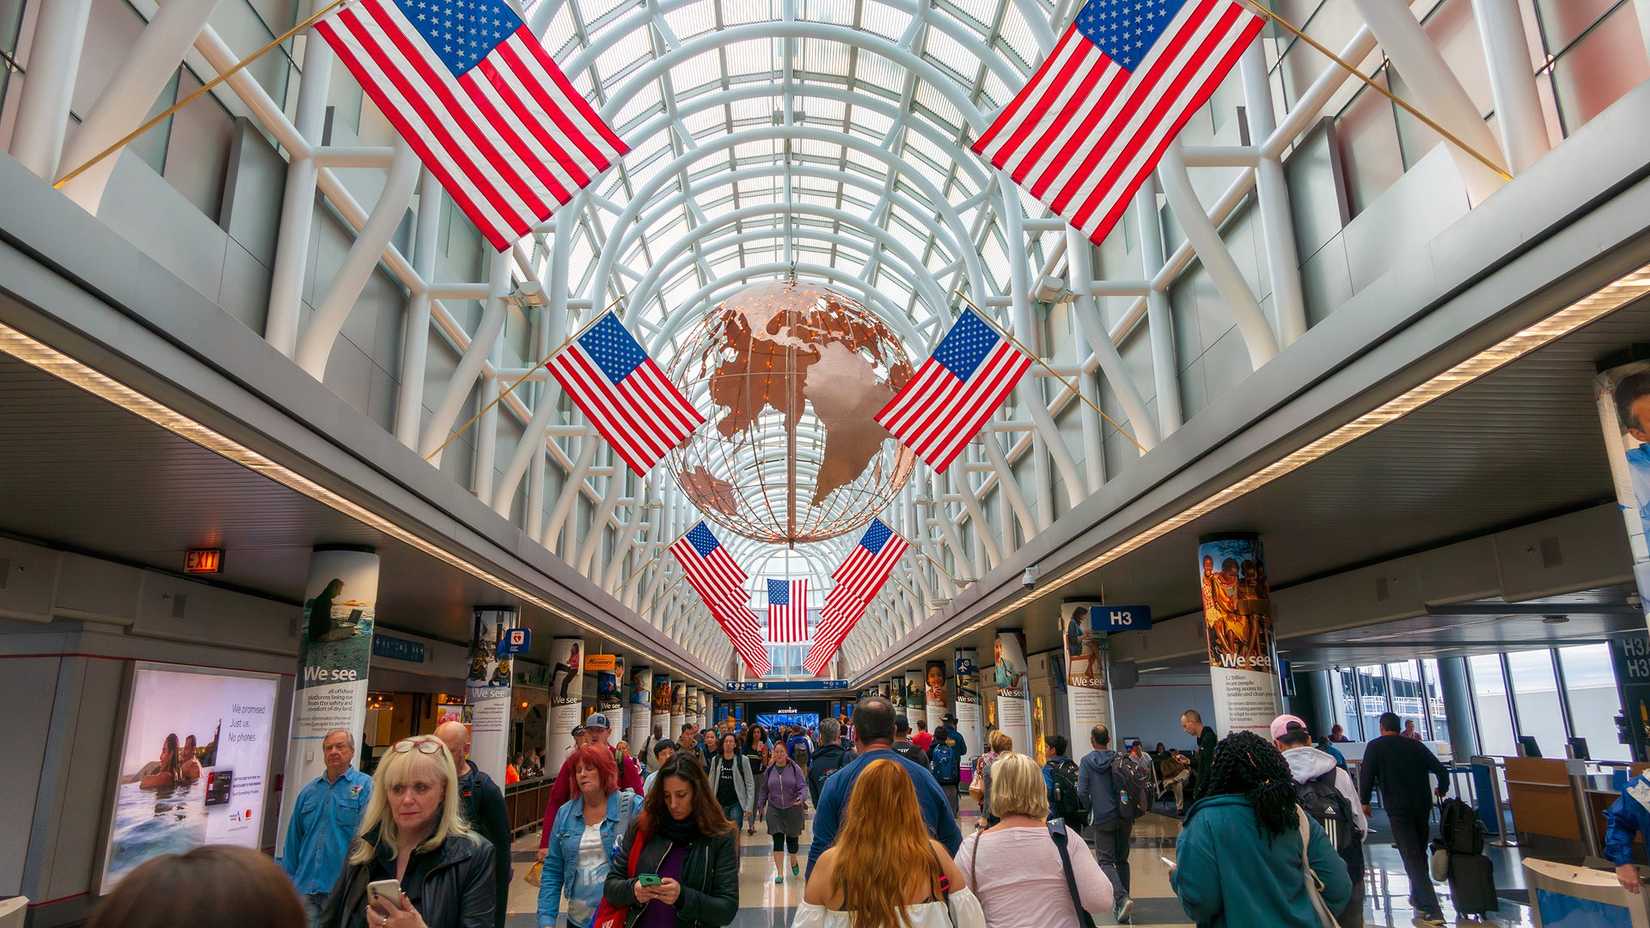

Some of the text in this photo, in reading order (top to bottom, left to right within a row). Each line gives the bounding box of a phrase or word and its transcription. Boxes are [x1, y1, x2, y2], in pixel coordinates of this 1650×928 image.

[187, 551, 217, 569] EXIT
[1110, 611, 1133, 625] H3
[1220, 653, 1272, 667] We see
[304, 666, 357, 681] We see
[1071, 677, 1088, 686] We
[471, 688, 505, 698] We see
[1001, 688, 1013, 697] We
[232, 703, 241, 713] We
[228, 732, 236, 742] No
